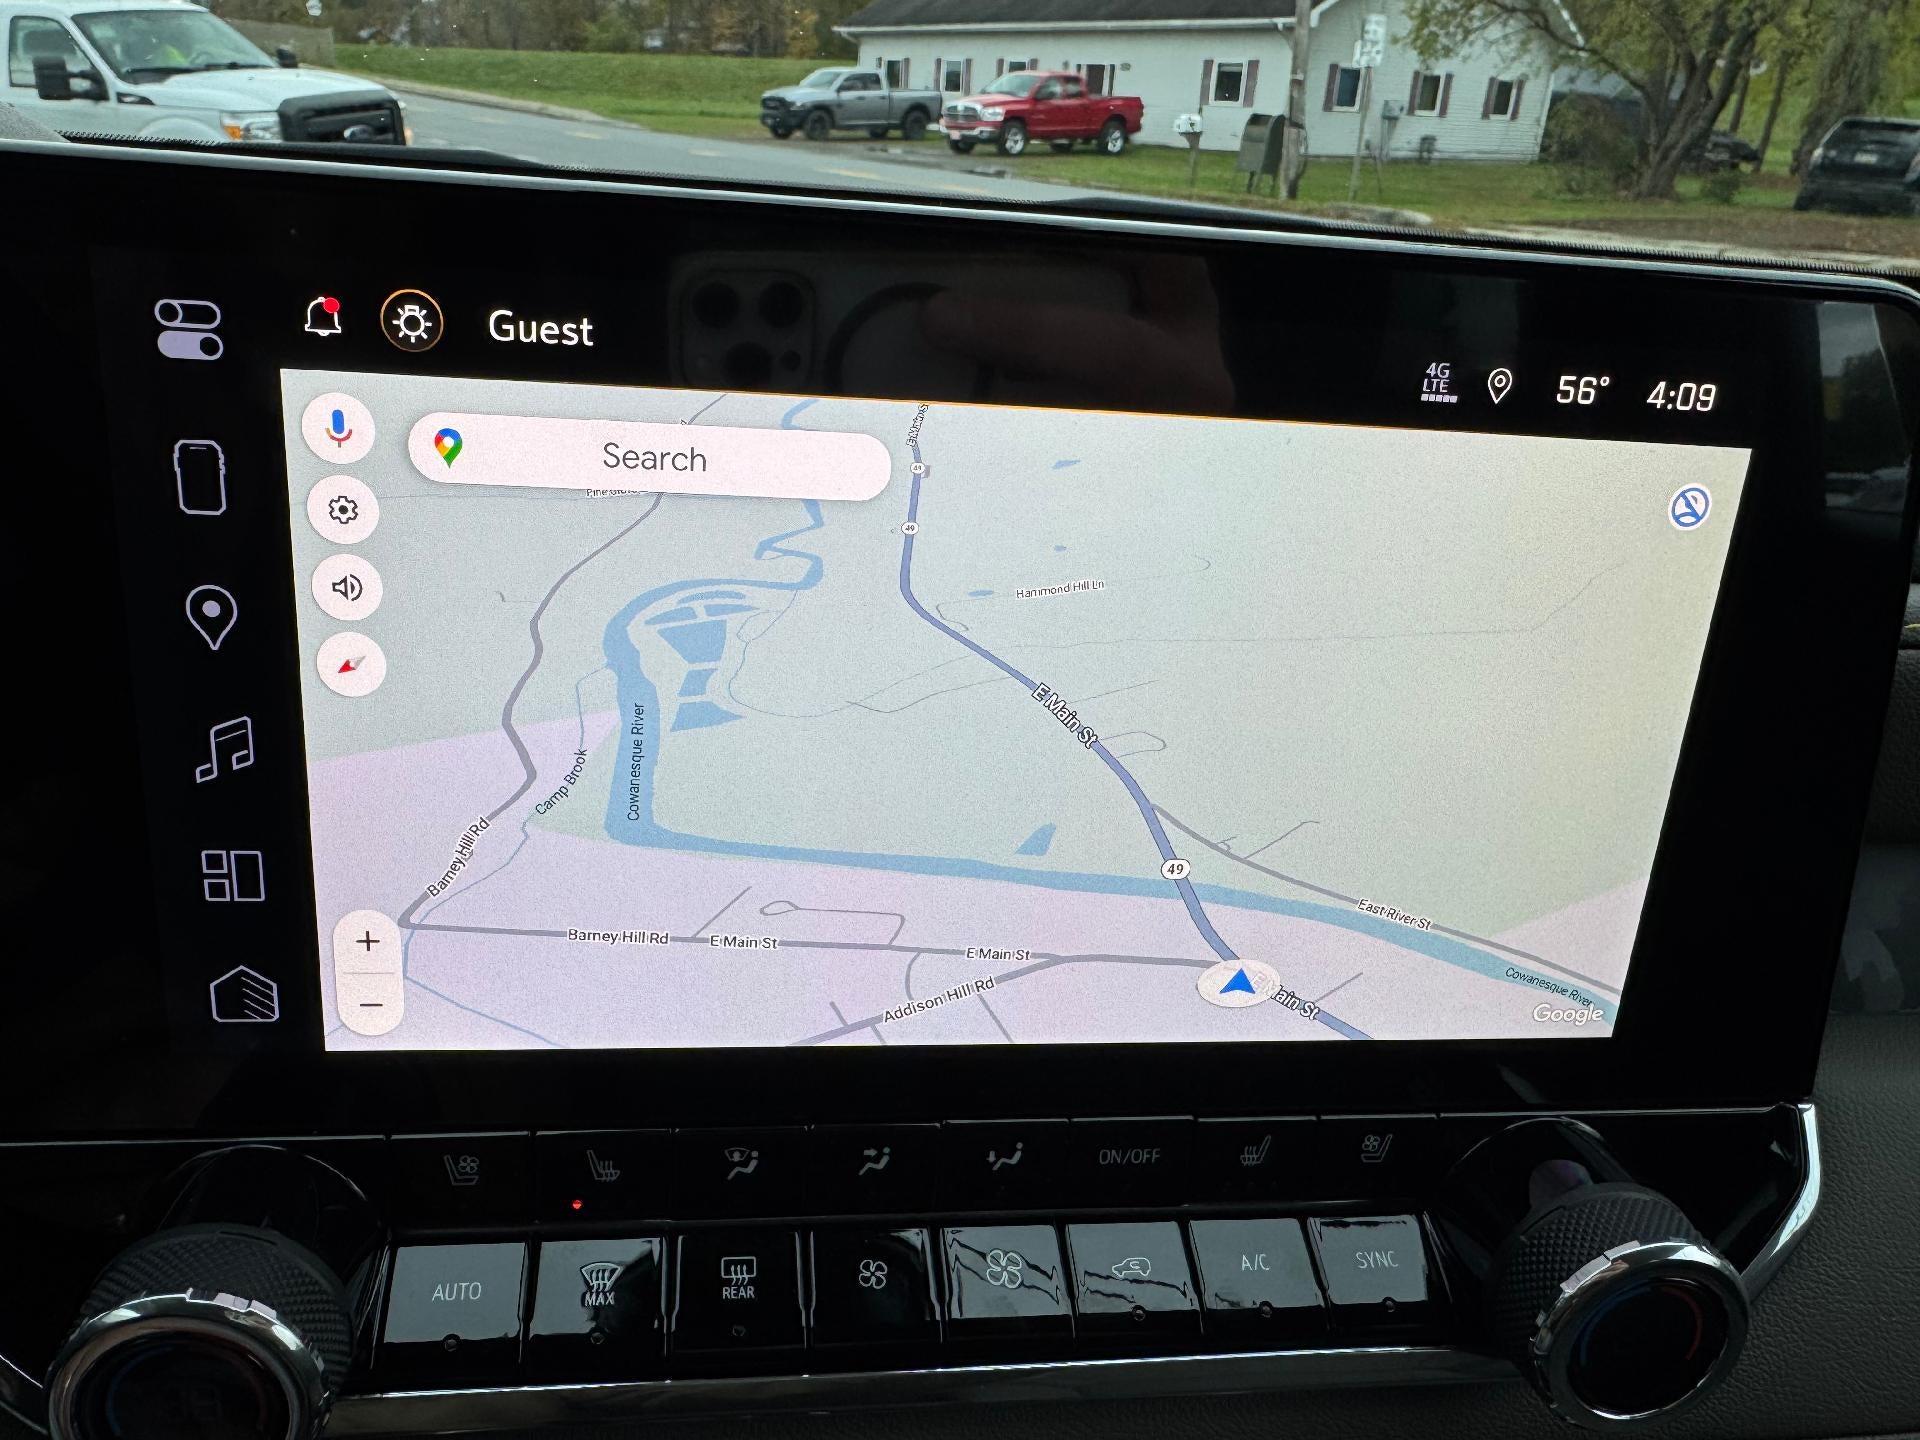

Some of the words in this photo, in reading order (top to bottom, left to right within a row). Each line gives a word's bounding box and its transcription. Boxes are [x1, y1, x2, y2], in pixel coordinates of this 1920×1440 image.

[489, 309, 594, 347] Guest
[1425, 362, 1450, 379] 4G
[1422, 379, 1450, 393] LTE
[1556, 375, 1610, 405] 56°
[1646, 381, 1717, 412] 4:09
[603, 441, 707, 473] Search
[1016, 582, 1070, 599] Hammond
[1073, 580, 1090, 593] Hill
[1092, 580, 1105, 590] Ln
[631, 703, 645, 736] River
[1031, 682, 1051, 703] E
[1043, 693, 1082, 734] Main
[1077, 726, 1099, 750] St
[535, 786, 570, 816] Camp
[563, 747, 588, 787] Brook
[627, 738, 645, 821] Cowanesque
[426, 856, 467, 898] Barney
[456, 831, 476, 859] Hill
[468, 816, 491, 838] Rd
[1166, 863, 1185, 876] 49
[1357, 898, 1386, 916] East
[1386, 907, 1418, 926] River
[1417, 917, 1432, 932] St
[567, 928, 619, 945] Barney
[622, 930, 646, 944] Hill
[649, 932, 669, 945] Rd
[710, 935, 720, 947] E
[723, 935, 758, 949] Main
[761, 937, 778, 949] St
[966, 947, 976, 959] E
[978, 948, 1011, 960] Main
[1015, 949, 1031, 961] St
[1505, 966, 1569, 997] Cowanesque
[1567, 988, 1593, 1008] River
[884, 995, 944, 1023] Addison
[946, 983, 972, 1002] Hill
[974, 976, 996, 993] Rd
[1300, 1001, 1320, 1021] St
[1533, 1003, 1605, 1027] Google
[1099, 1148, 1161, 1166] ON/OFF
[1241, 1253, 1270, 1272] A/C
[1355, 1250, 1400, 1270] SYNC
[431, 1281, 482, 1302] AUTO
[584, 1290, 616, 1307] MAX
[722, 1285, 756, 1300] REAR
